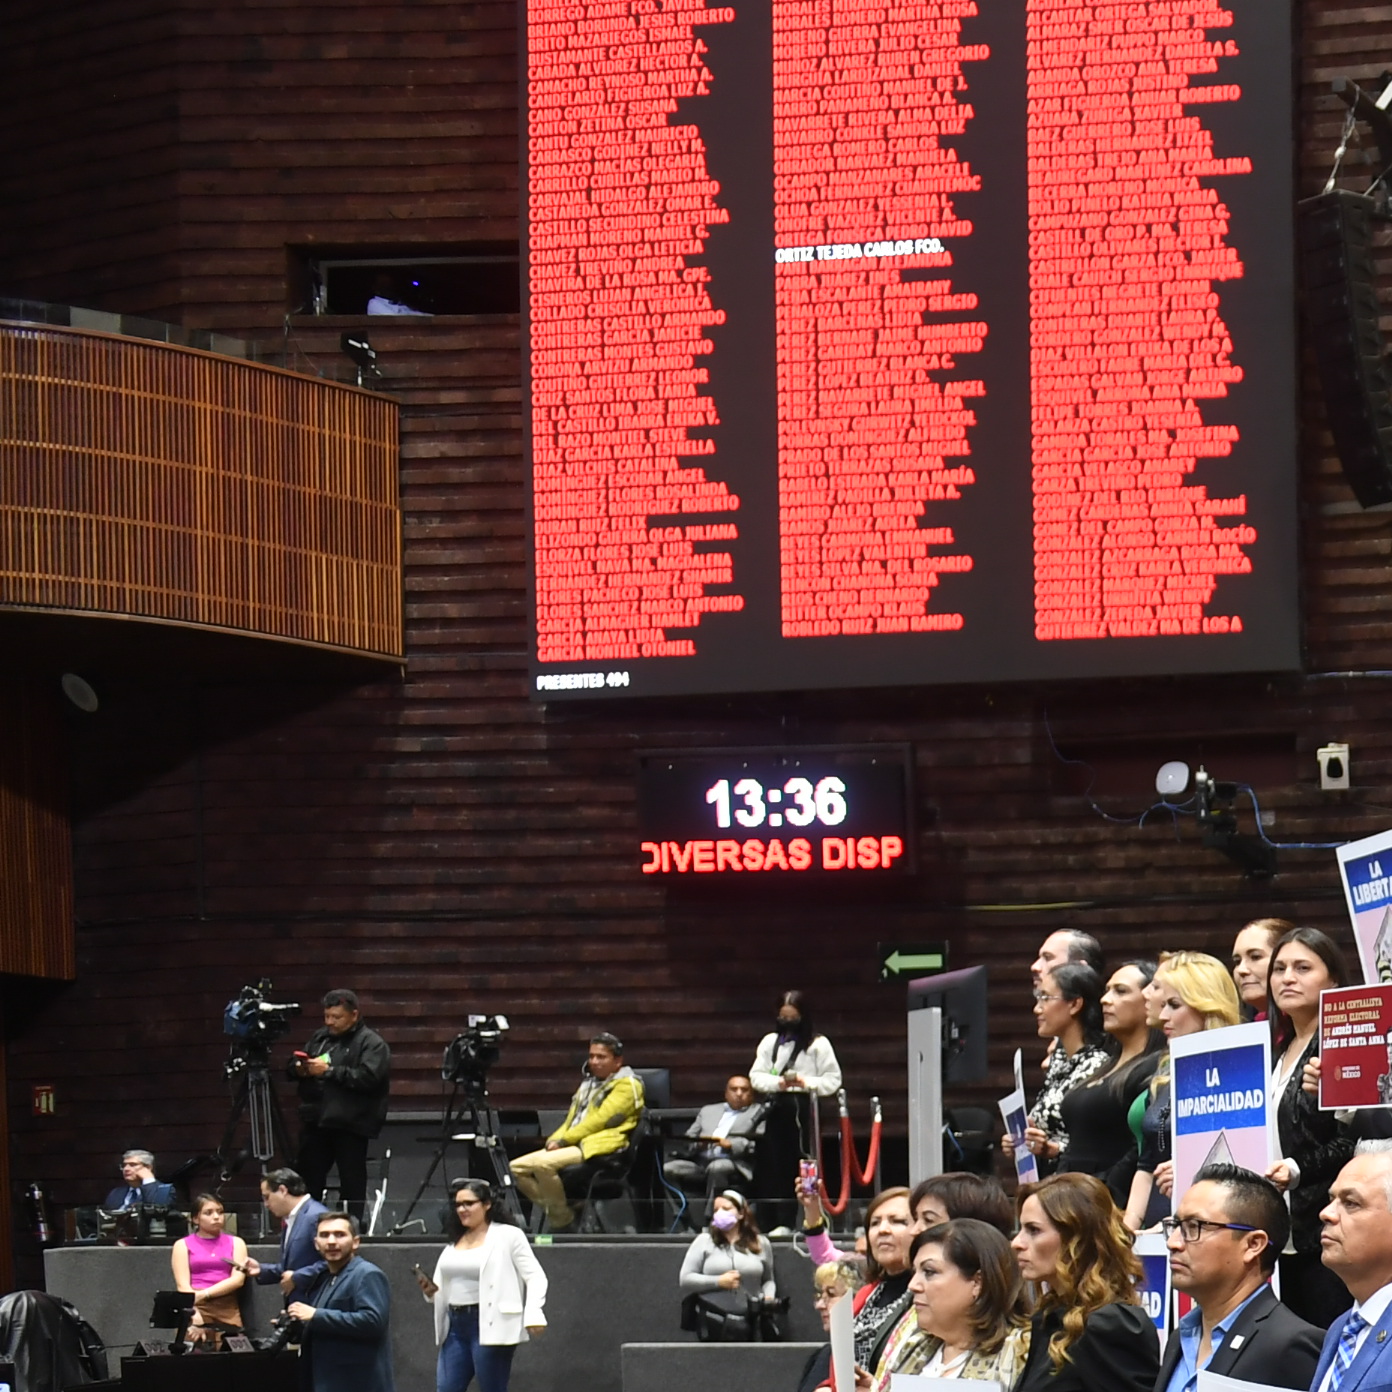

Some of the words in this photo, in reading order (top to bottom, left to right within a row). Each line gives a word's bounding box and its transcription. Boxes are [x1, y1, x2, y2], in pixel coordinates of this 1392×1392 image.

[775, 247, 814, 263] ORTIZ
[864, 240, 913, 257] CARLOS
[536, 673, 604, 690] PRESENTES
[706, 776, 847, 828] 13:36
[822, 836, 902, 869] DISP
[1369, 861, 1383, 878] LA
[1206, 1068, 1220, 1087] LA
[1178, 1089, 1263, 1117] IMPARCIALIDAD
